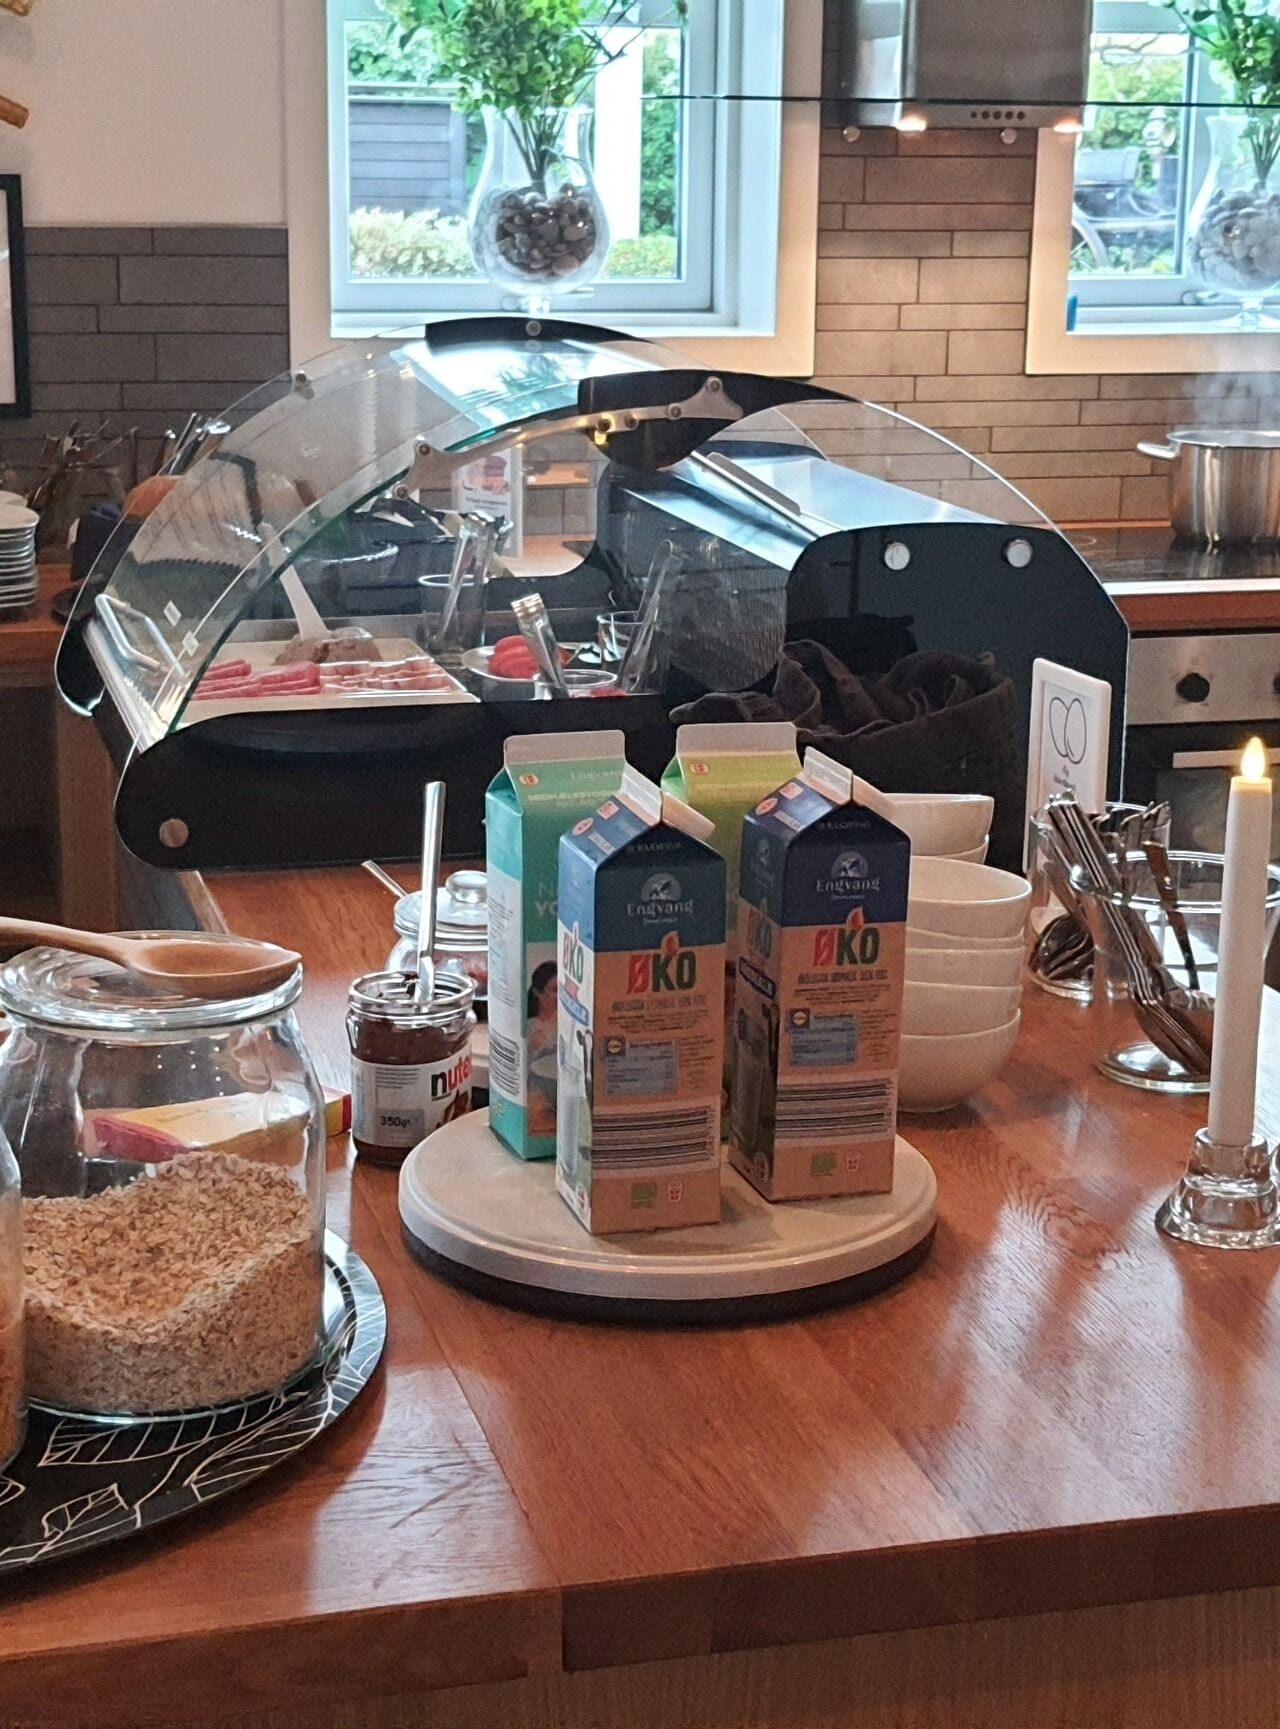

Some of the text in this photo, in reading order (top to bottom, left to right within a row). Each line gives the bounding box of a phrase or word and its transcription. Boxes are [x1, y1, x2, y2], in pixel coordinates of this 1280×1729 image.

[816, 877, 881, 893] Engvang
[626, 899, 695, 917] Engvang
[813, 927, 880, 967] ØKO
[626, 951, 697, 994] ØKO
[431, 1056, 472, 1097] nute
